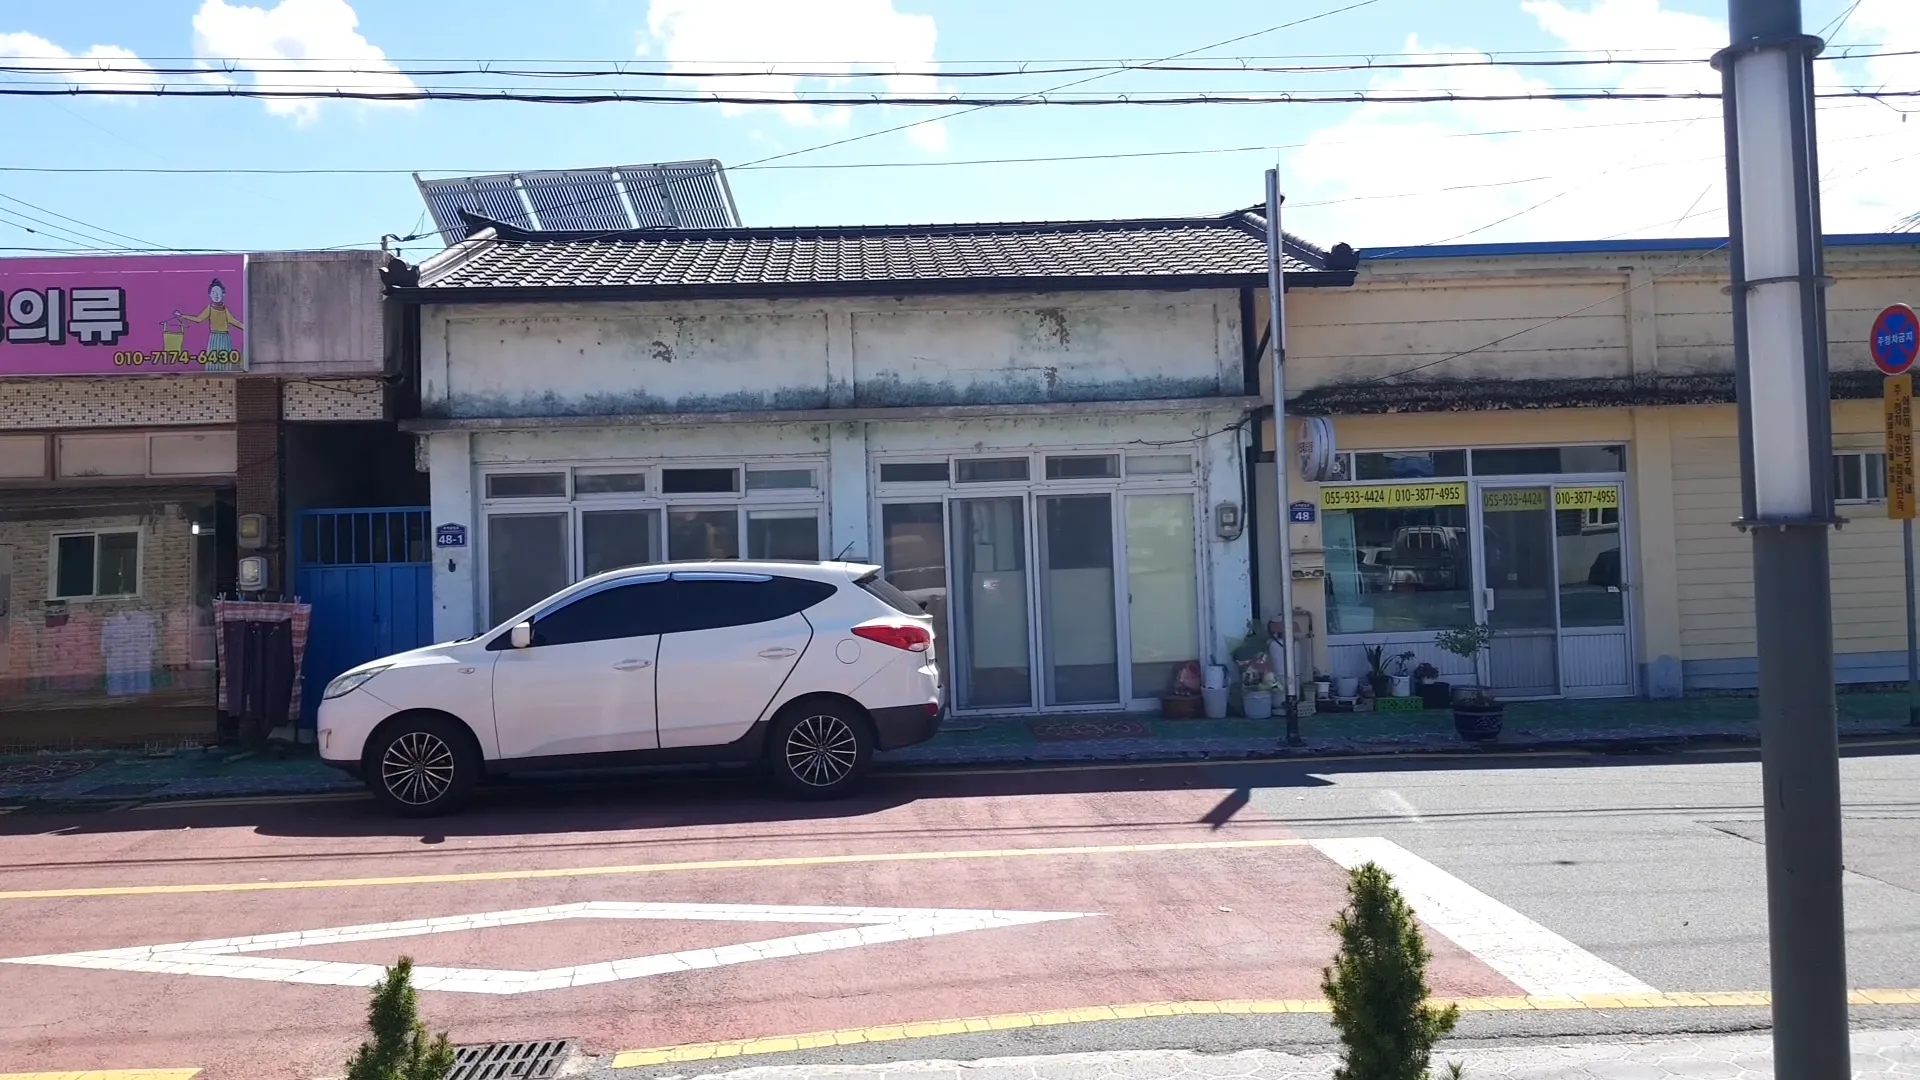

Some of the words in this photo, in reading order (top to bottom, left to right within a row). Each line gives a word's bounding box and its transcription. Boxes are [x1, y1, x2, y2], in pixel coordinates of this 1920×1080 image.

[1877, 331, 1913, 347] 주정차금지
[113, 350, 241, 366] 010-7174-6430
[1324, 489, 1385, 505] 055-933-4424
[1394, 487, 1460, 503] 010-3877-4955
[1483, 492, 1543, 508] 055-933-4424
[1555, 490, 1616, 505] 010-3877-4955
[1295, 511, 1310, 521] 48
[438, 534, 463, 545] 48-1
